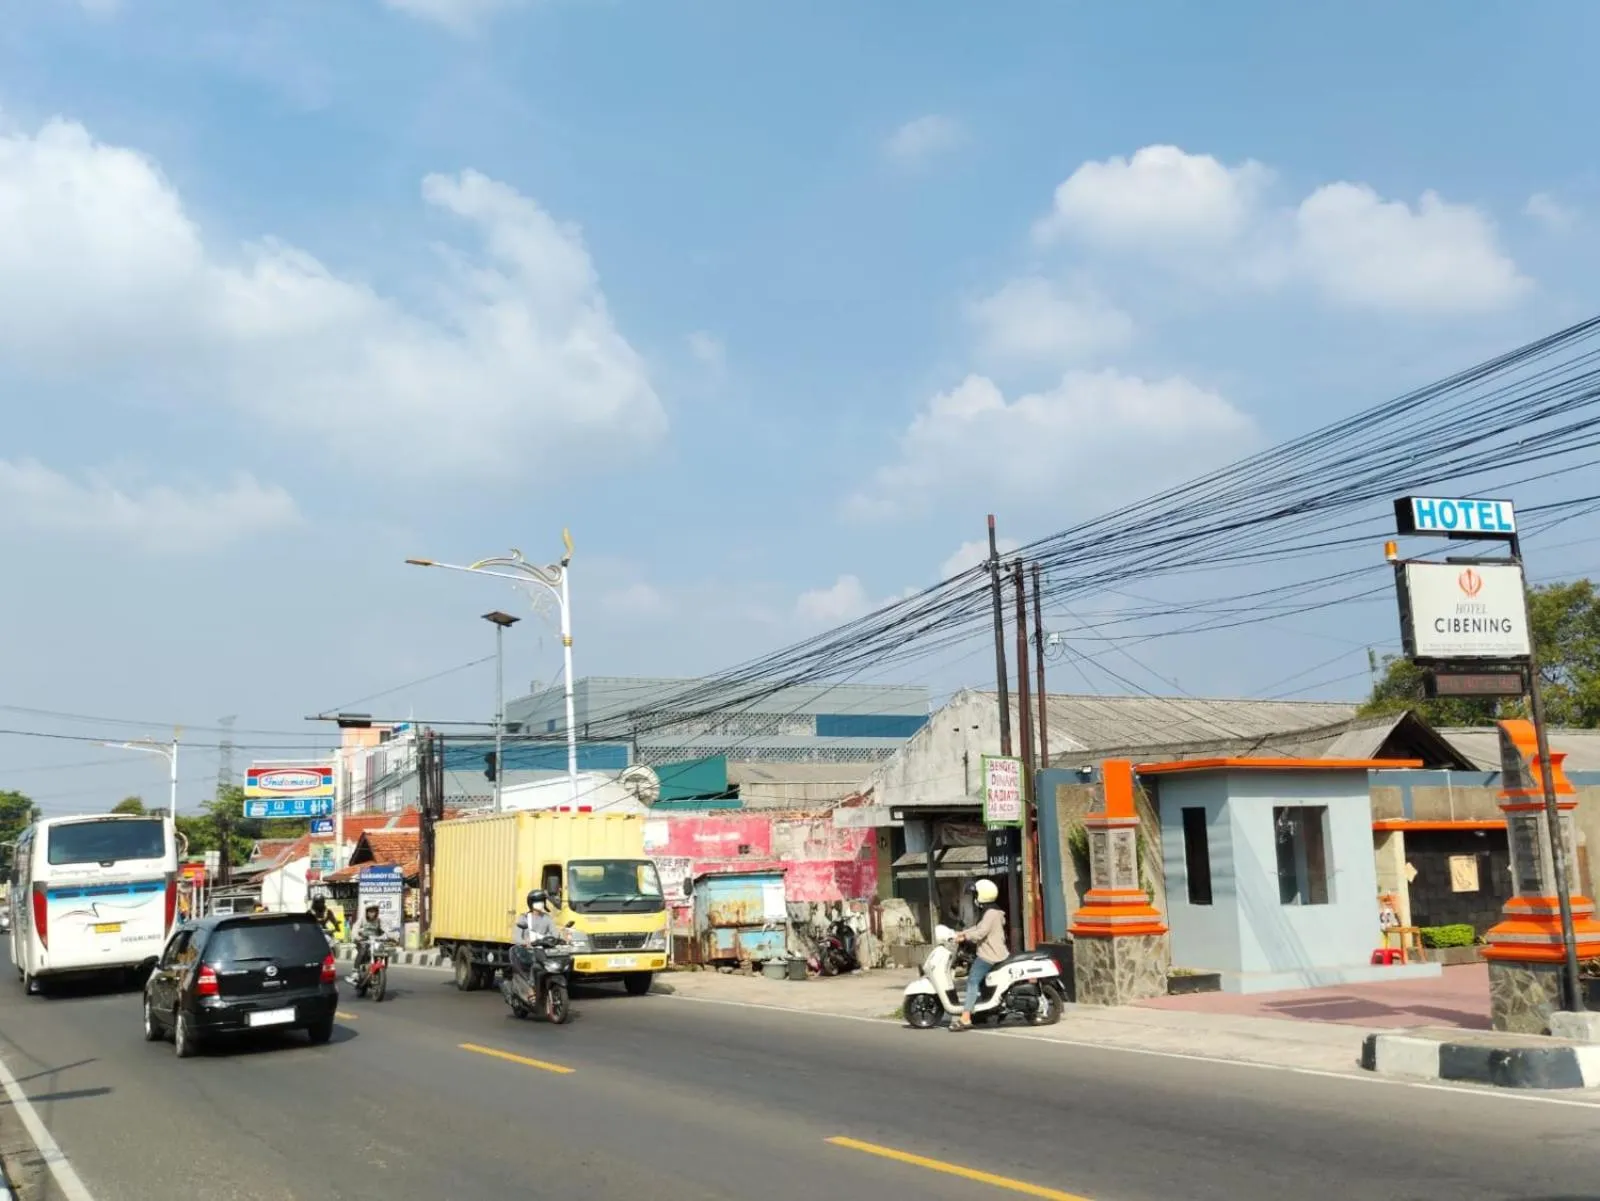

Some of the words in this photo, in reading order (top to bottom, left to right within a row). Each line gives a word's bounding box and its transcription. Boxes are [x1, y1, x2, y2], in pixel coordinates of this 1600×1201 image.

[1415, 499, 1513, 531] HOTEL
[1455, 603, 1488, 615] HOTEL
[1434, 617, 1513, 633] CIBENING
[989, 760, 1018, 774] BENGKEL
[261, 775, 318, 787] Indomaret
